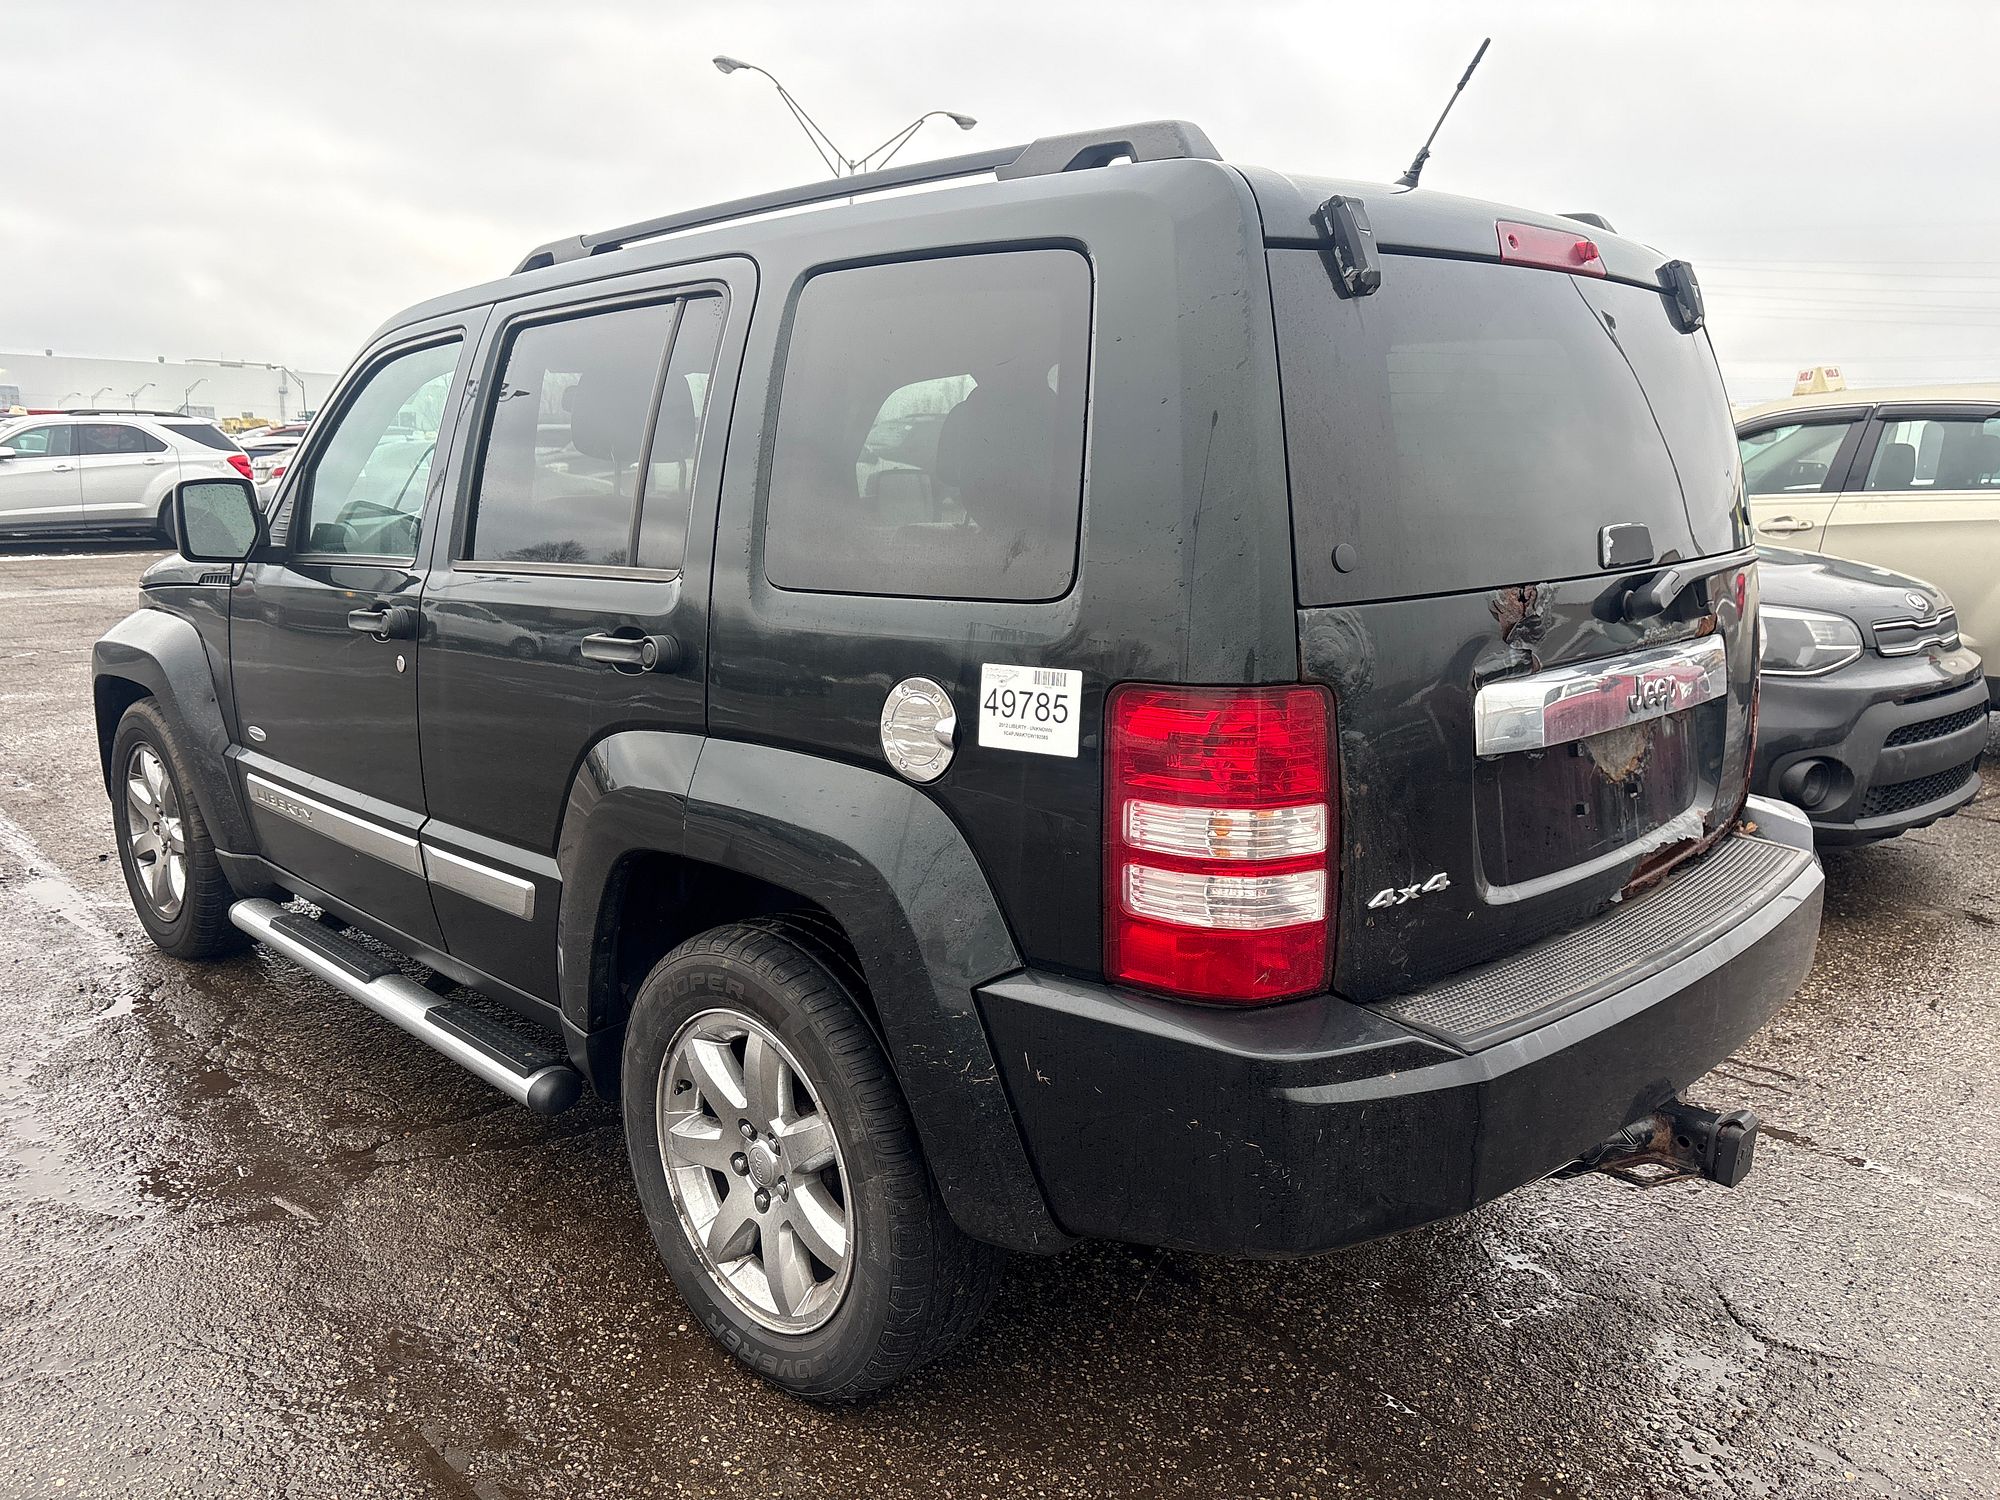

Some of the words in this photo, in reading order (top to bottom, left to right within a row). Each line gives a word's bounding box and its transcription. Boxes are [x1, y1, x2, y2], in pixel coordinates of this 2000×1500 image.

[984, 688, 1068, 723] 49785
[1627, 674, 1677, 713] Jeep
[256, 787, 313, 823] LIBERTY
